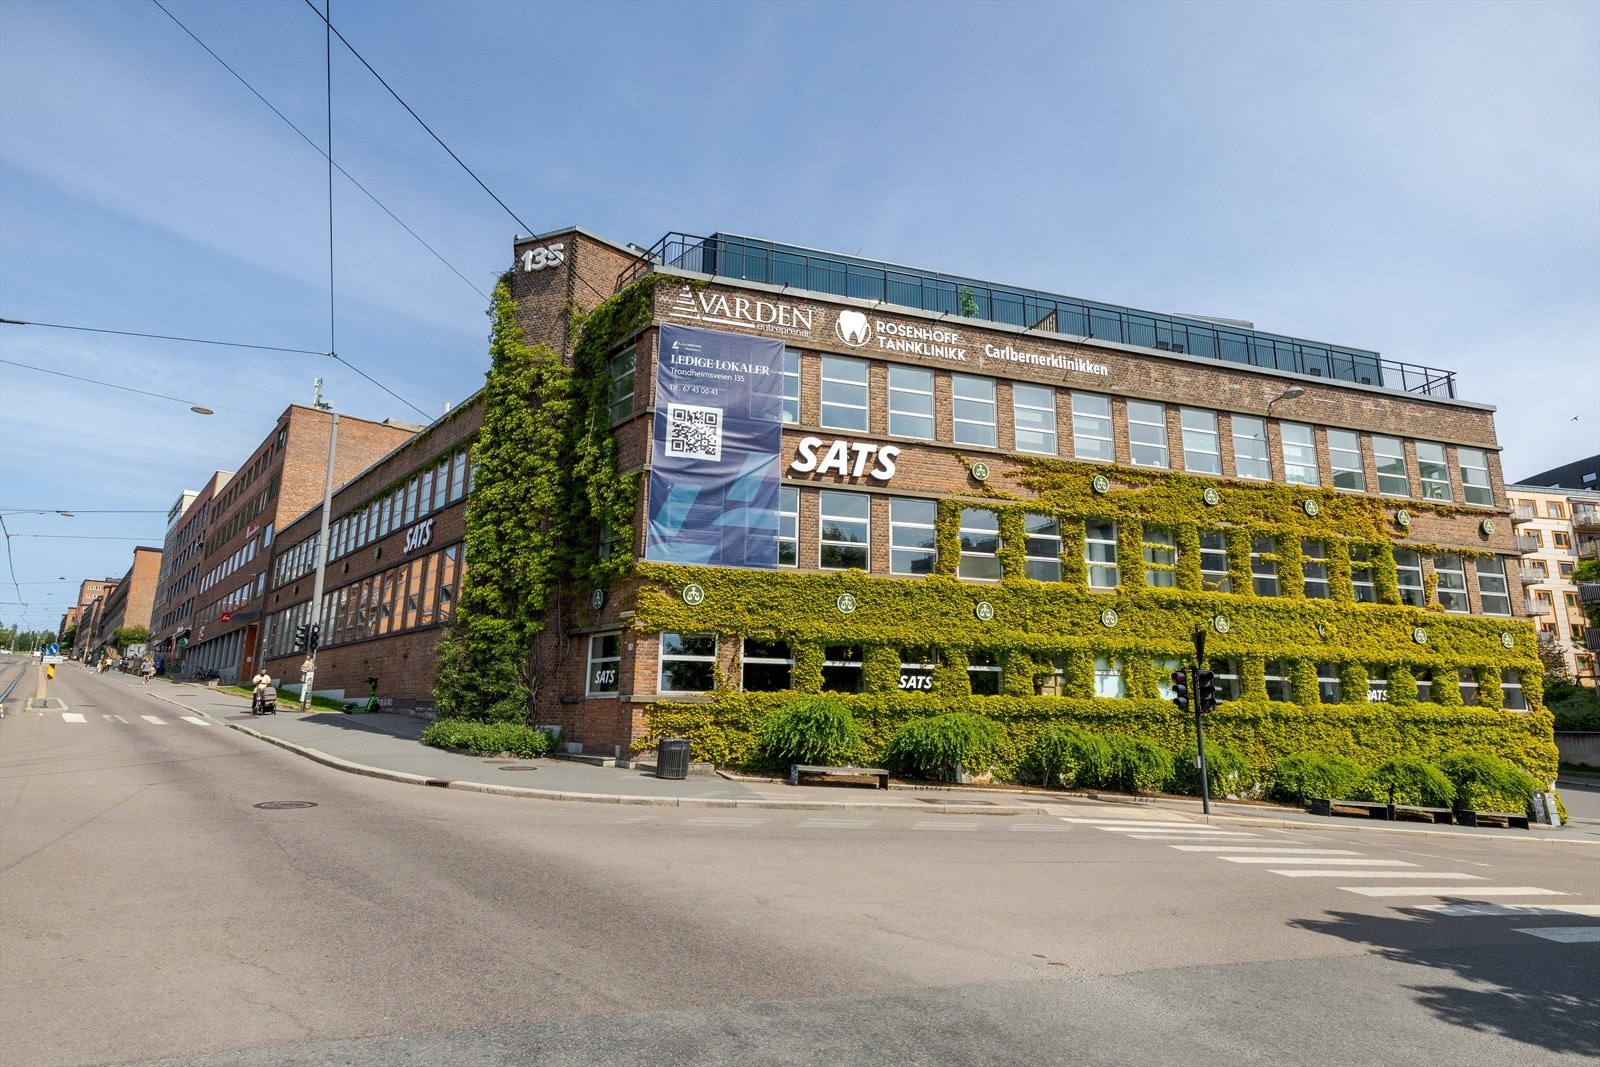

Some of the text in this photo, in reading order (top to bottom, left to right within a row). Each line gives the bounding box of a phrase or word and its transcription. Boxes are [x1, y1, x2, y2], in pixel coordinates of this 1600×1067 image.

[521, 243, 564, 272] 135
[697, 291, 813, 330] VARDEN
[876, 320, 959, 345] ROSENHOFF
[877, 336, 967, 362] TANNKLINIKK
[985, 343, 1109, 377] Carlbernerklinikken
[670, 366, 745, 382] Trondheimsveien 135
[671, 354, 770, 376] LEDIGE LOKALER
[682, 385, 691, 393] 67
[691, 386, 700, 394] 43
[700, 387, 710, 395] 00
[710, 388, 719, 396] 43
[790, 436, 902, 480] SATS
[403, 518, 433, 554] SATS
[594, 669, 616, 684] SATS
[898, 675, 934, 690] SATS
